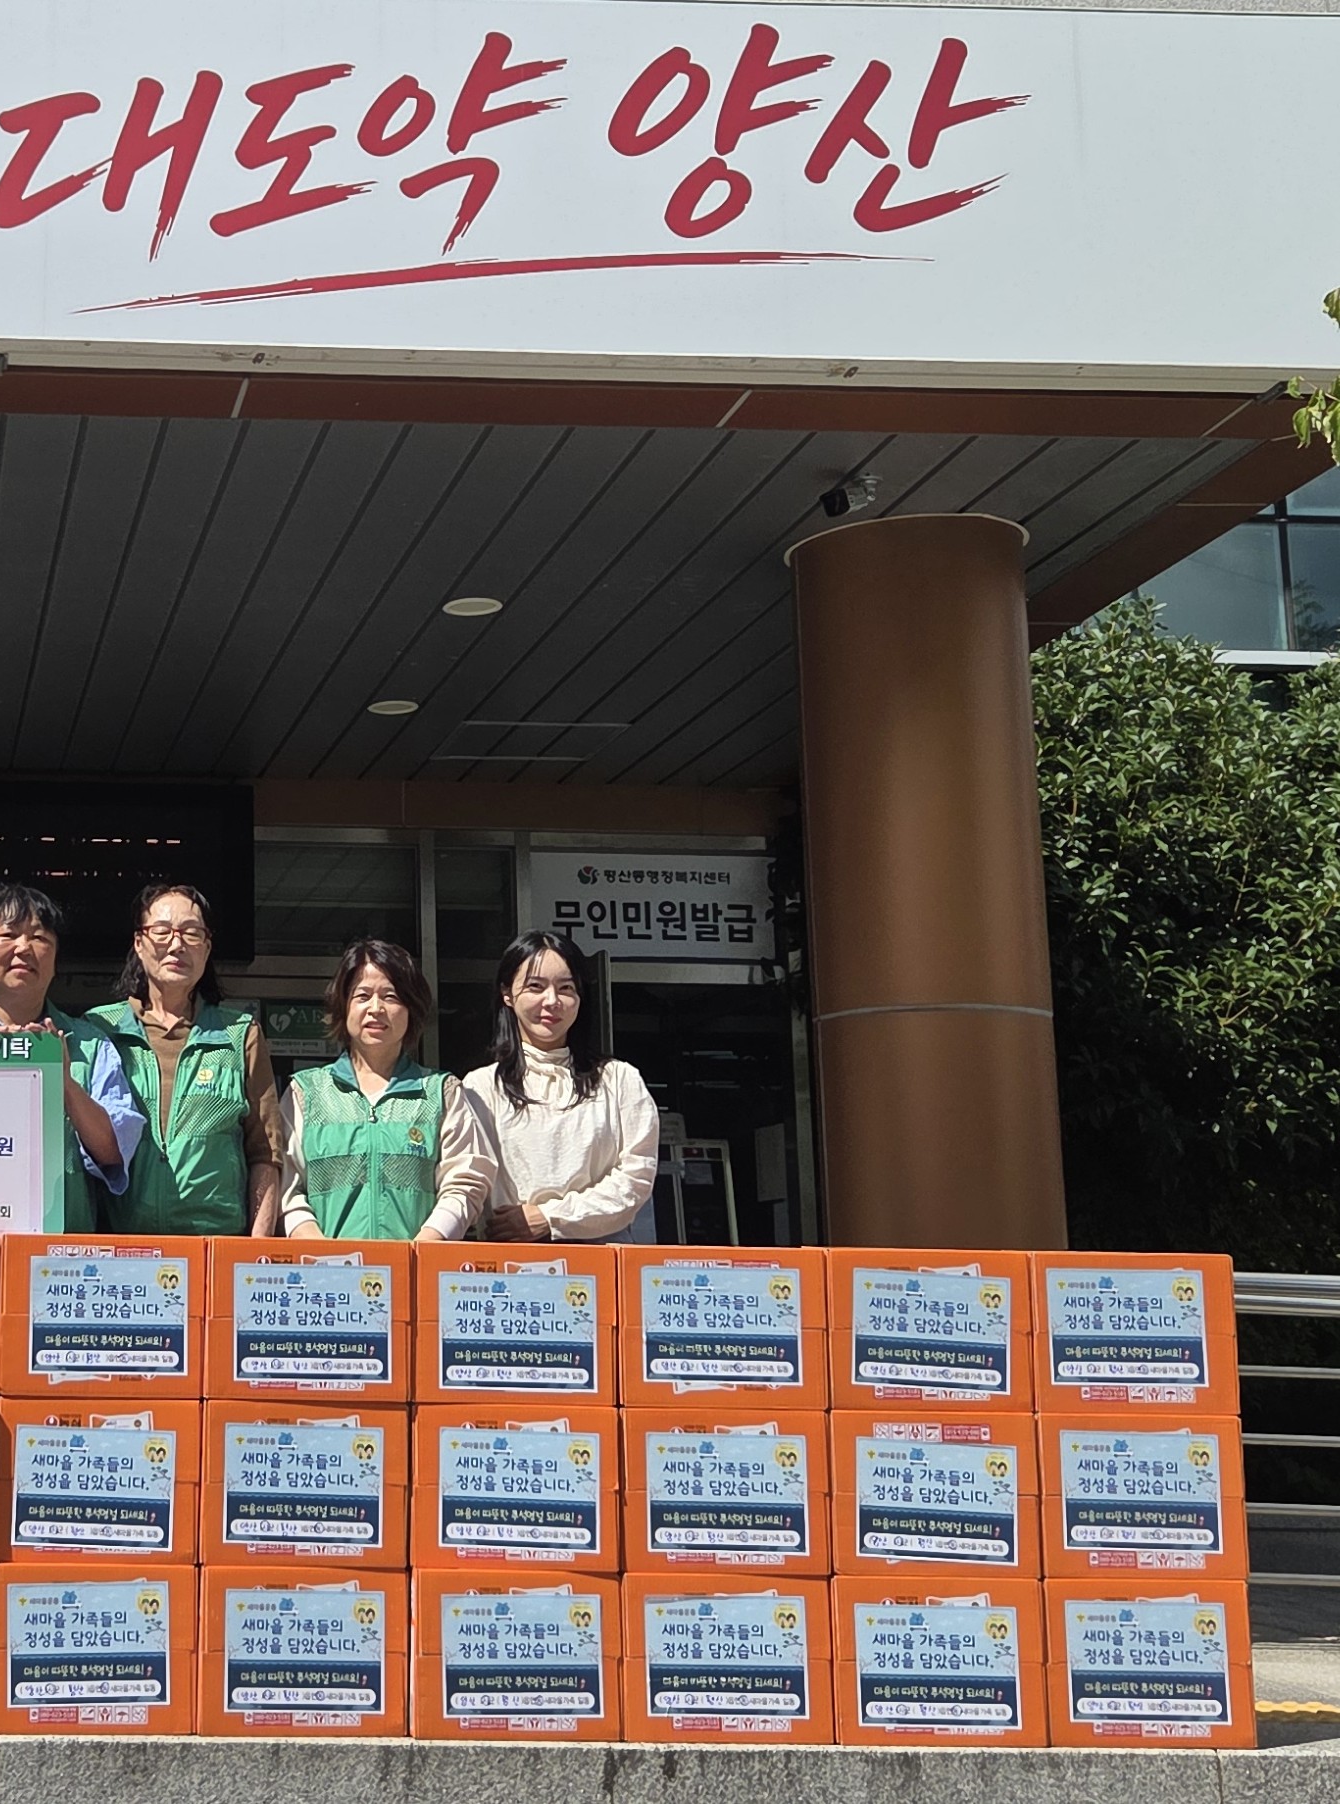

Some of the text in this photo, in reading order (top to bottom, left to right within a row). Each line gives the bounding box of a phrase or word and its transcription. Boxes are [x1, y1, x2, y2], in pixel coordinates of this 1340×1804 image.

[608, 23, 1032, 239] 양산
[603, 869, 731, 885] 평산동행정복지센터
[552, 900, 757, 943] 무인민원발급
[45, 1284, 147, 1300] 새마을 가족들의
[250, 1291, 350, 1308] 새마을 가족들의
[46, 1302, 165, 1318] 정성을 담았습니다.
[454, 1300, 555, 1317] 새마을 가족들의
[658, 1293, 759, 1311] 새마을 가족들의
[868, 1297, 969, 1318] 새마을 가족들의
[1063, 1296, 1163, 1312] 새마을 가족들의
[250, 1309, 368, 1326] 정성을 담았습니다.
[455, 1318, 573, 1335] 정성을 담았습니다.
[659, 1311, 777, 1328] 정성을 담았습니다.
[869, 1314, 987, 1337] 정성을 담았습니다.
[1065, 1314, 1181, 1330] 정성을 담았습니다.
[30, 1454, 134, 1473] 새마을 가족들의
[240, 1452, 342, 1470] 새마을 가족들의
[455, 1456, 558, 1476] 새마을 가족들의
[662, 1461, 765, 1478] 새마을 가족들의
[1077, 1459, 1178, 1477] 새마을 가족들의
[30, 1472, 151, 1492] 정성을 담았습니다.
[240, 1470, 360, 1489] 정성을 담았습니다.
[456, 1474, 576, 1494] 정성을 담았습니다.
[872, 1466, 975, 1487] 새마을 가족들의
[663, 1479, 783, 1497] 정성을 담았습니다.
[873, 1484, 993, 1506] 정성을 담았습니다.
[1078, 1477, 1197, 1495] 정성을 담았습니다.
[23, 1611, 127, 1630] 새마을 가족들의
[241, 1618, 343, 1635] 새마을 가족들의
[24, 1628, 146, 1648] 정성을 담았습니다.
[458, 1623, 559, 1641] 새마을 가족들의
[661, 1623, 764, 1640] 새마을 가족들의
[1082, 1629, 1184, 1647] 새마을 가족들의
[241, 1637, 361, 1654] 정성을 담았습니다.
[459, 1641, 578, 1659] 정성을 담았습니다.
[663, 1642, 783, 1659] 정성을 담았습니다.
[872, 1633, 975, 1651] 새마을 가족들의
[873, 1652, 994, 1669] 정성을 담았습니다.
[1084, 1648, 1204, 1665] 정성을 담았습니다.
